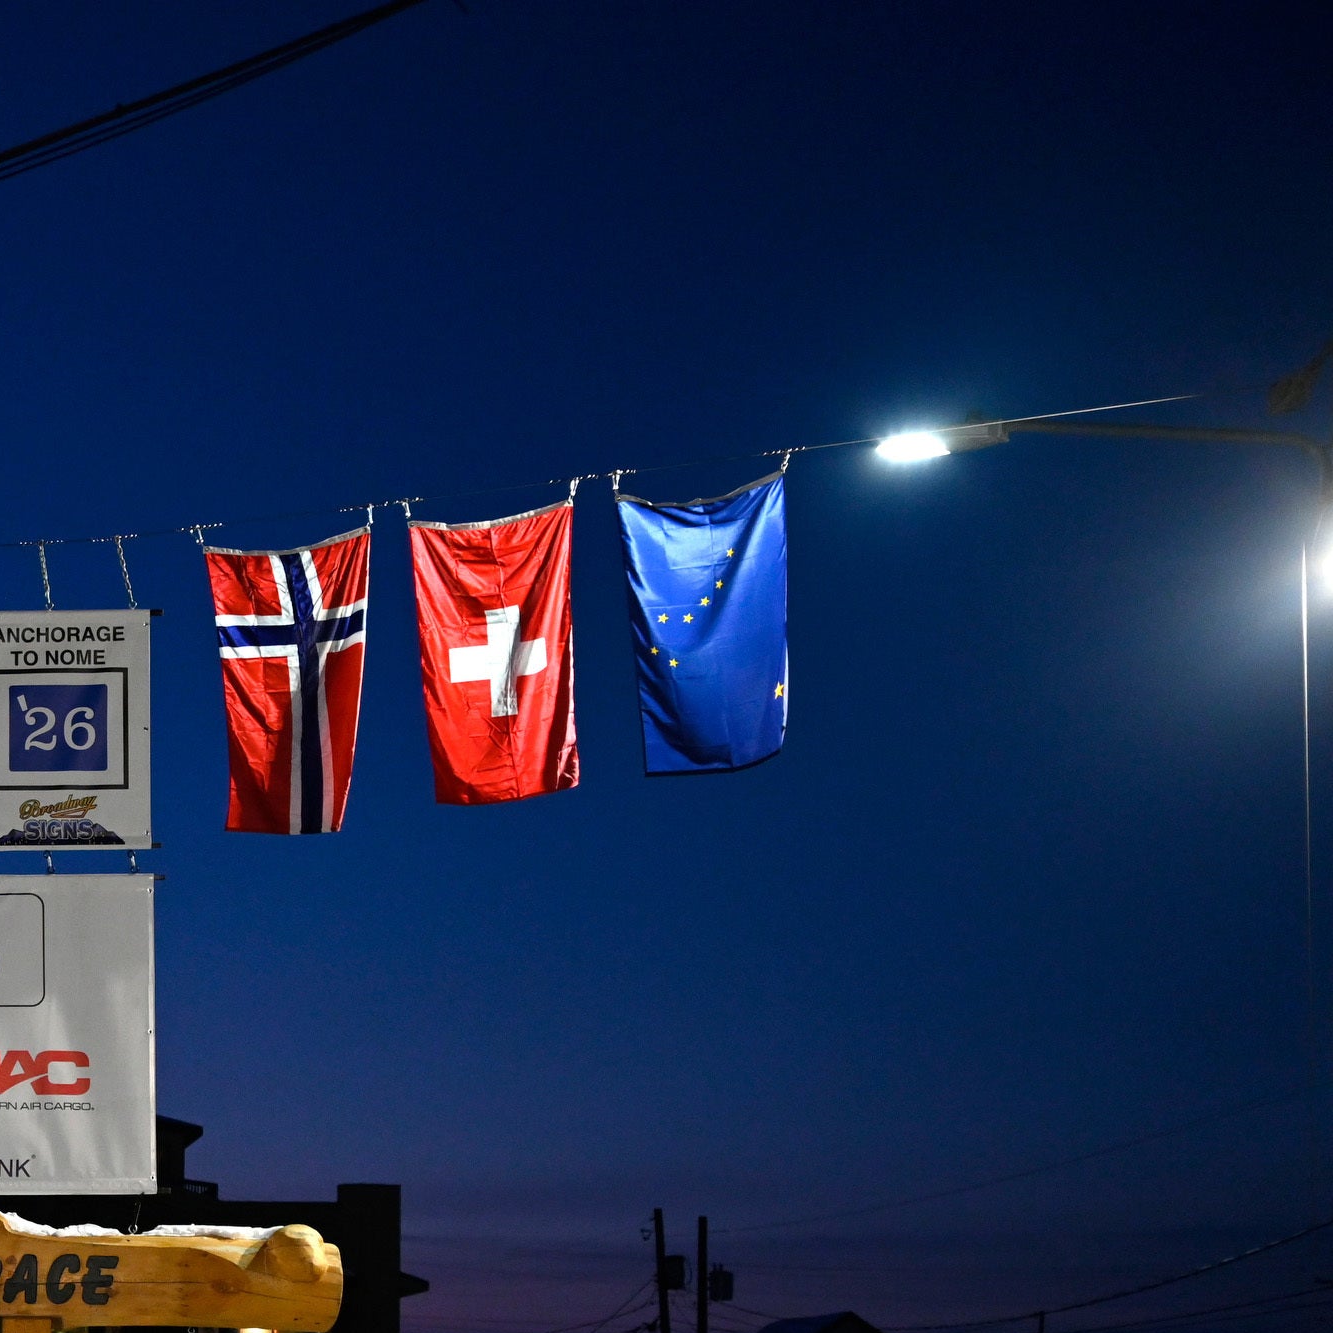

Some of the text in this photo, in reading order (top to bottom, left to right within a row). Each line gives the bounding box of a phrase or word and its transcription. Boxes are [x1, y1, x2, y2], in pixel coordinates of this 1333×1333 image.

[10, 648, 107, 667] TO NOME
[19, 794, 97, 819] Broadway
[23, 819, 94, 840] SIGNS
[20, 1101, 42, 1111] AIR
